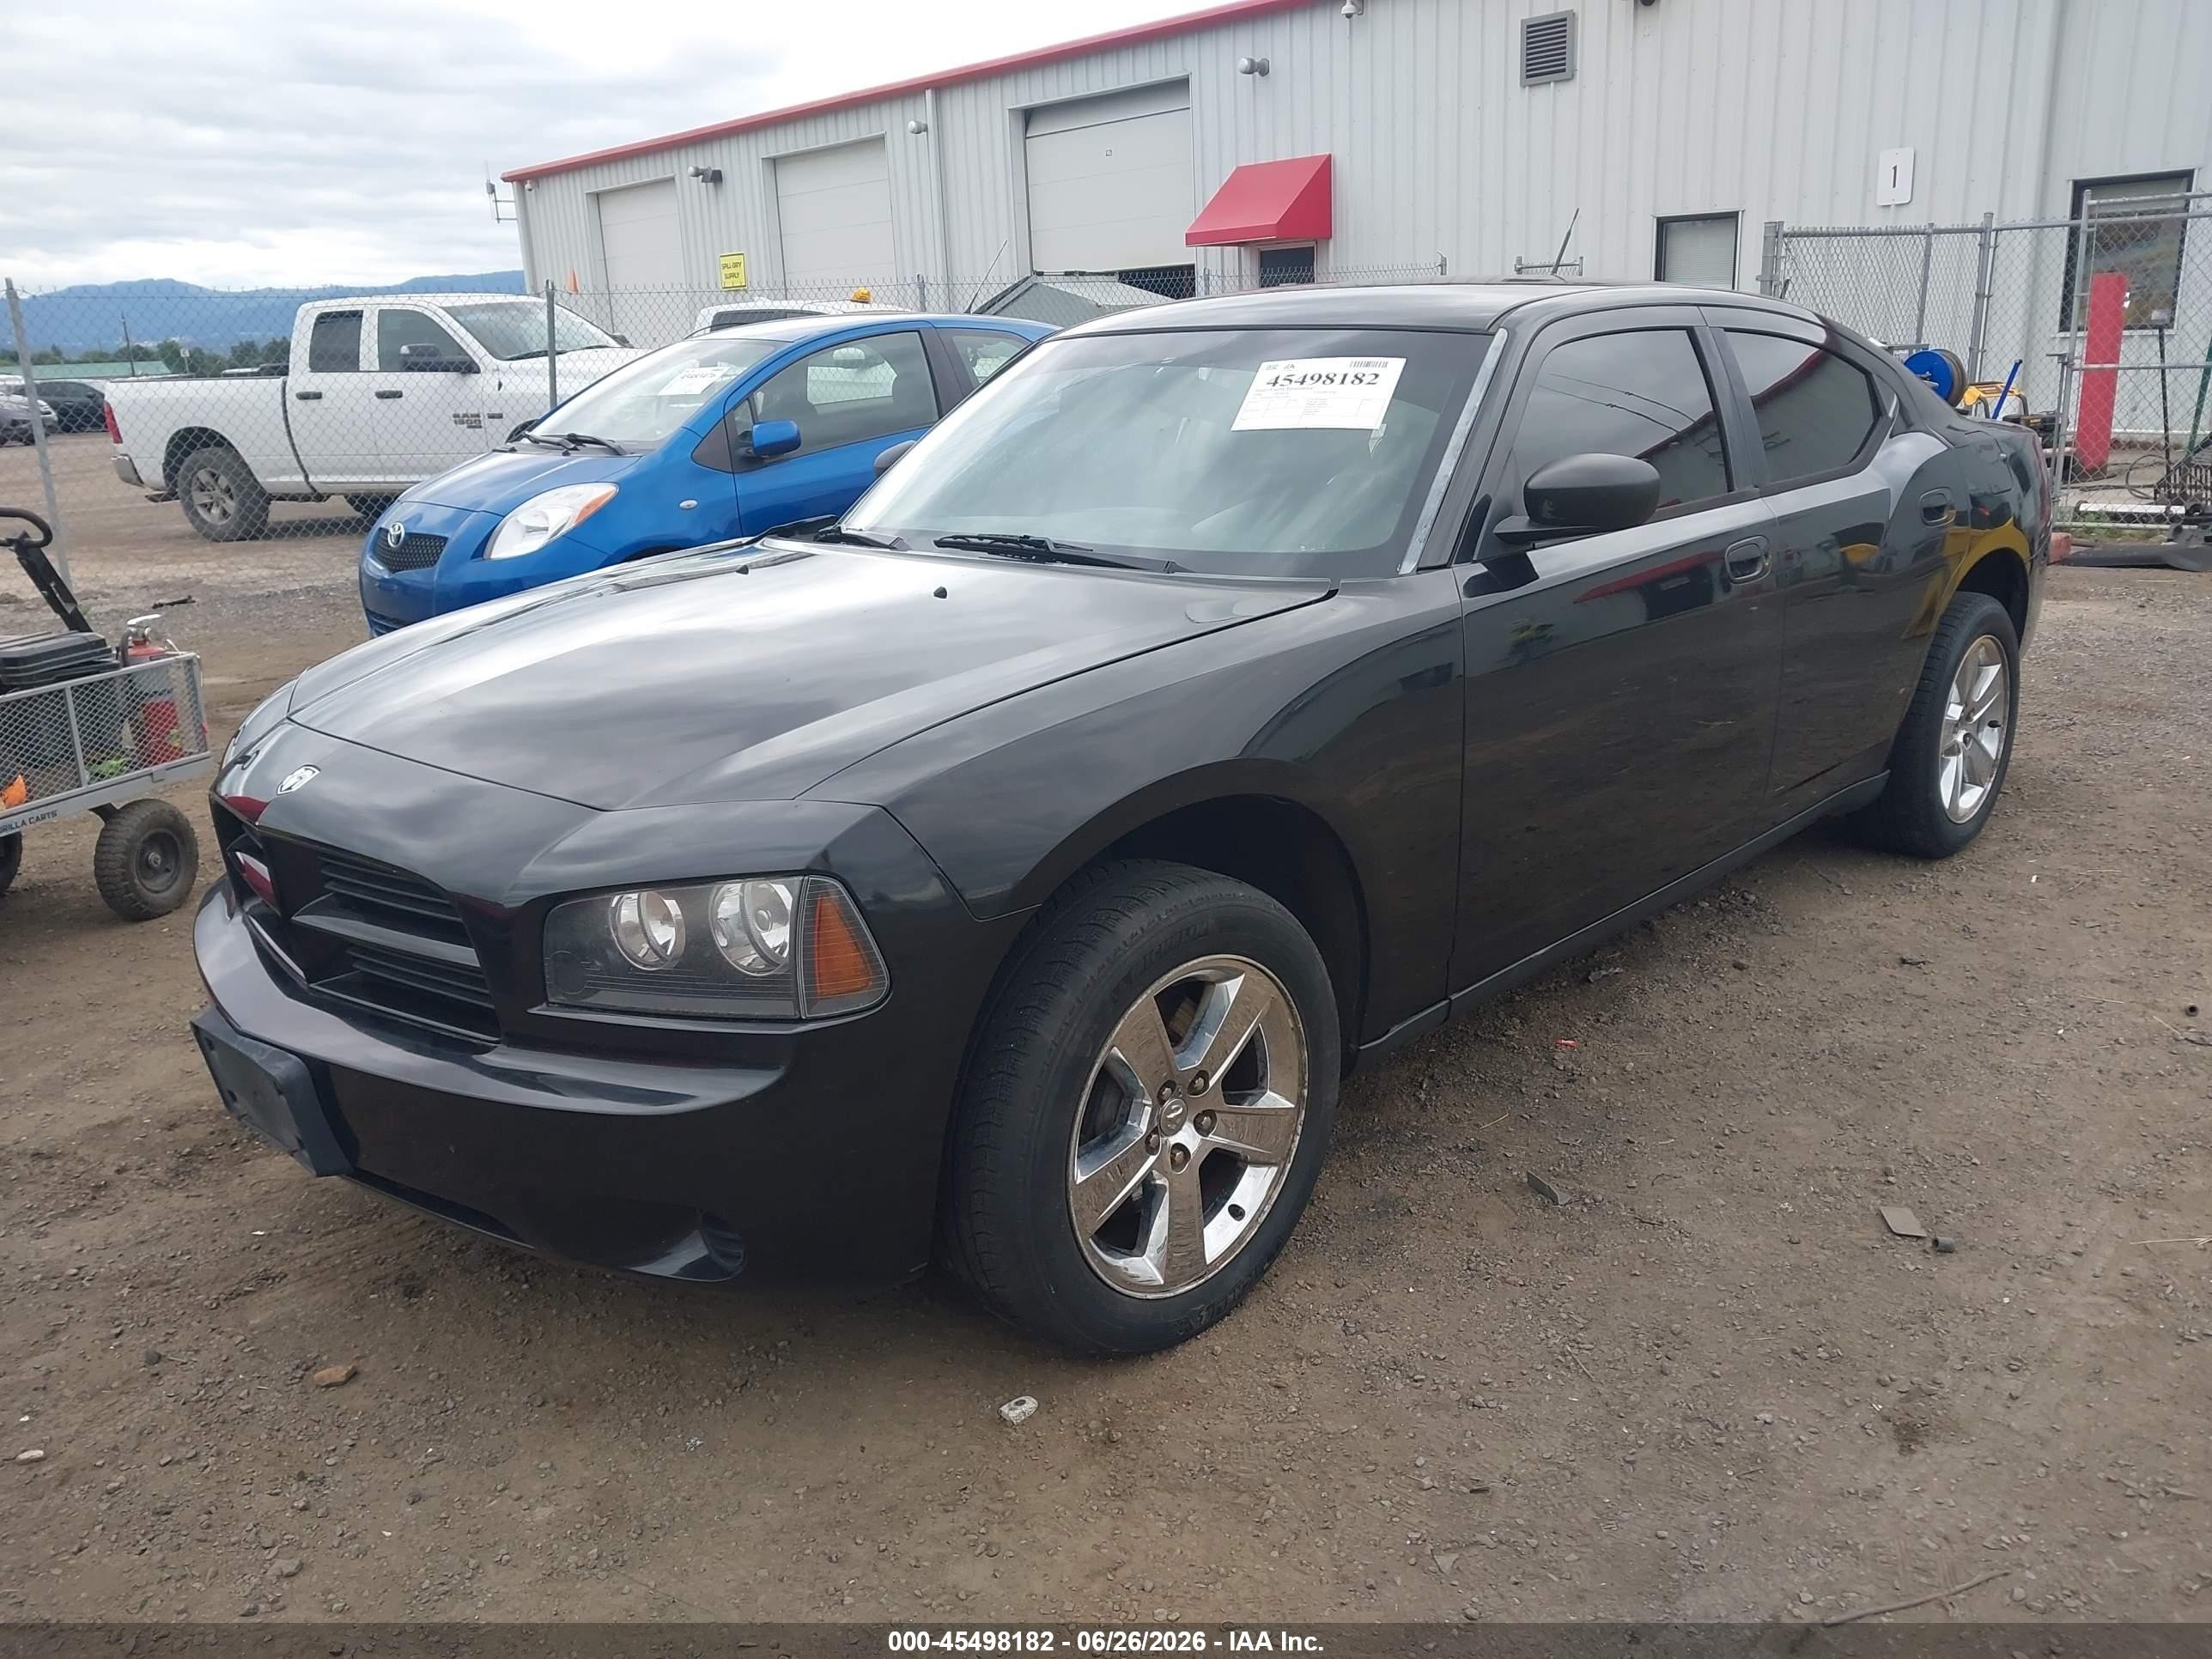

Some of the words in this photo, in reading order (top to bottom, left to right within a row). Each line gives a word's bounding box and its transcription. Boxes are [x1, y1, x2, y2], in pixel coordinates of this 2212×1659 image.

[1892, 164, 1898, 189] 1
[1266, 372, 1381, 387] 45498182
[28, 810, 58, 824] CARTS
